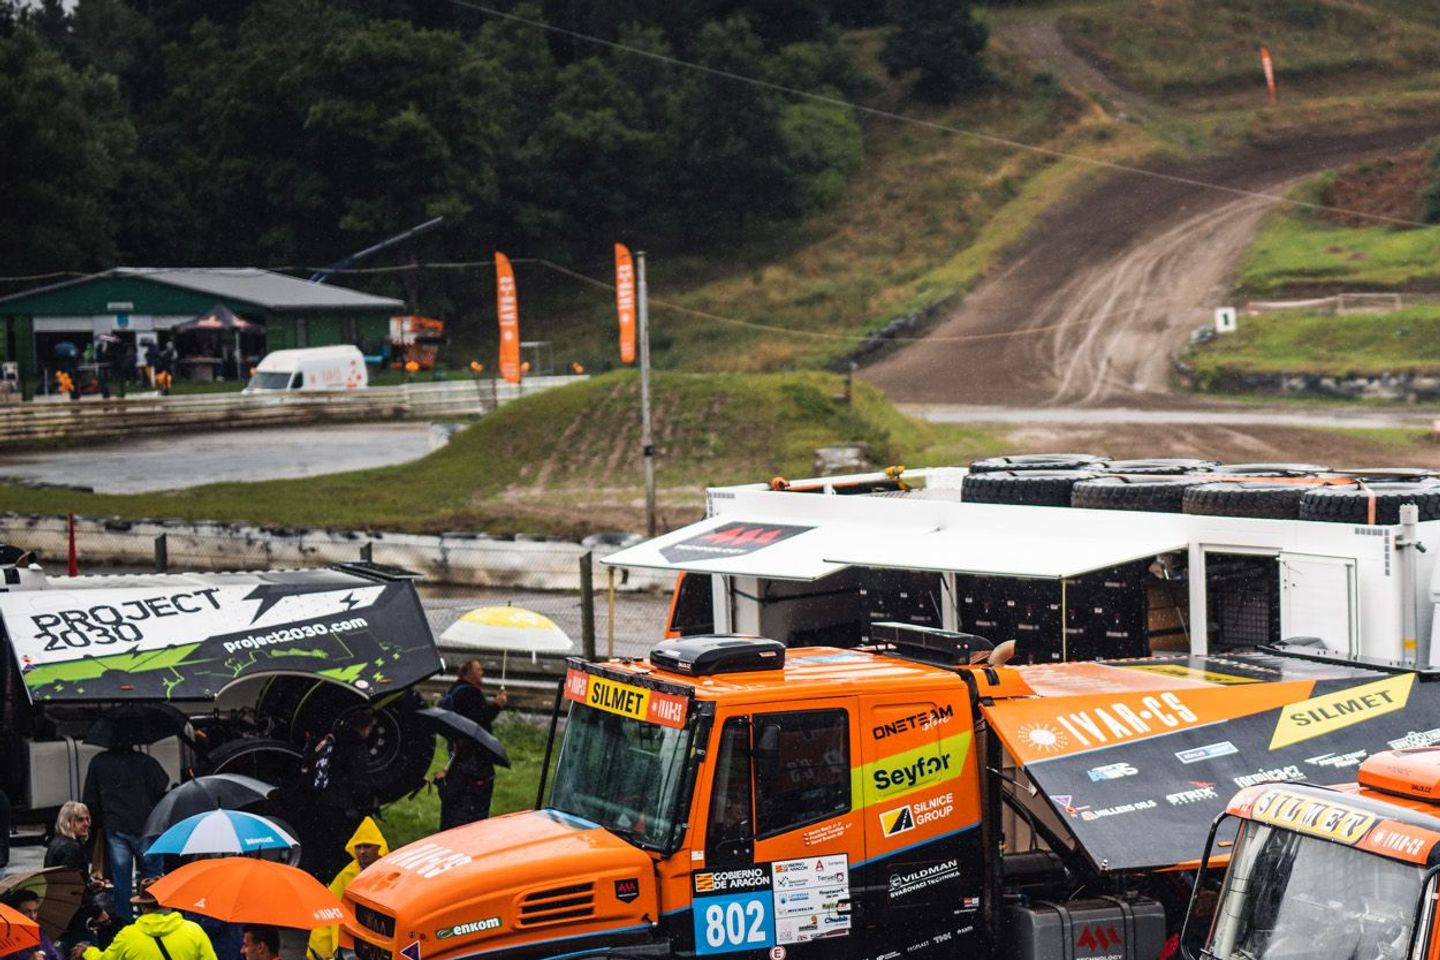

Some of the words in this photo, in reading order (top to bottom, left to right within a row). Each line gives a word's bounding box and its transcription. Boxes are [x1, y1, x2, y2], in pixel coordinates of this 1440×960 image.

[31, 587, 220, 635] PROJECT
[35, 622, 143, 653] 2030
[223, 616, 368, 654] project2030.com
[591, 682, 644, 716] SILMET
[1290, 689, 1395, 726] SILMET
[873, 705, 954, 740] ONETEAM
[873, 753, 951, 789] Seyfor
[913, 793, 953, 814] SILNICE
[916, 805, 953, 826] GROUP
[1256, 792, 1365, 841] SILMET
[714, 868, 763, 882] GOBIERNO
[714, 880, 727, 890] DE
[902, 859, 958, 884] VILDMAN
[453, 917, 500, 936] enkom
[706, 899, 766, 948] 802
